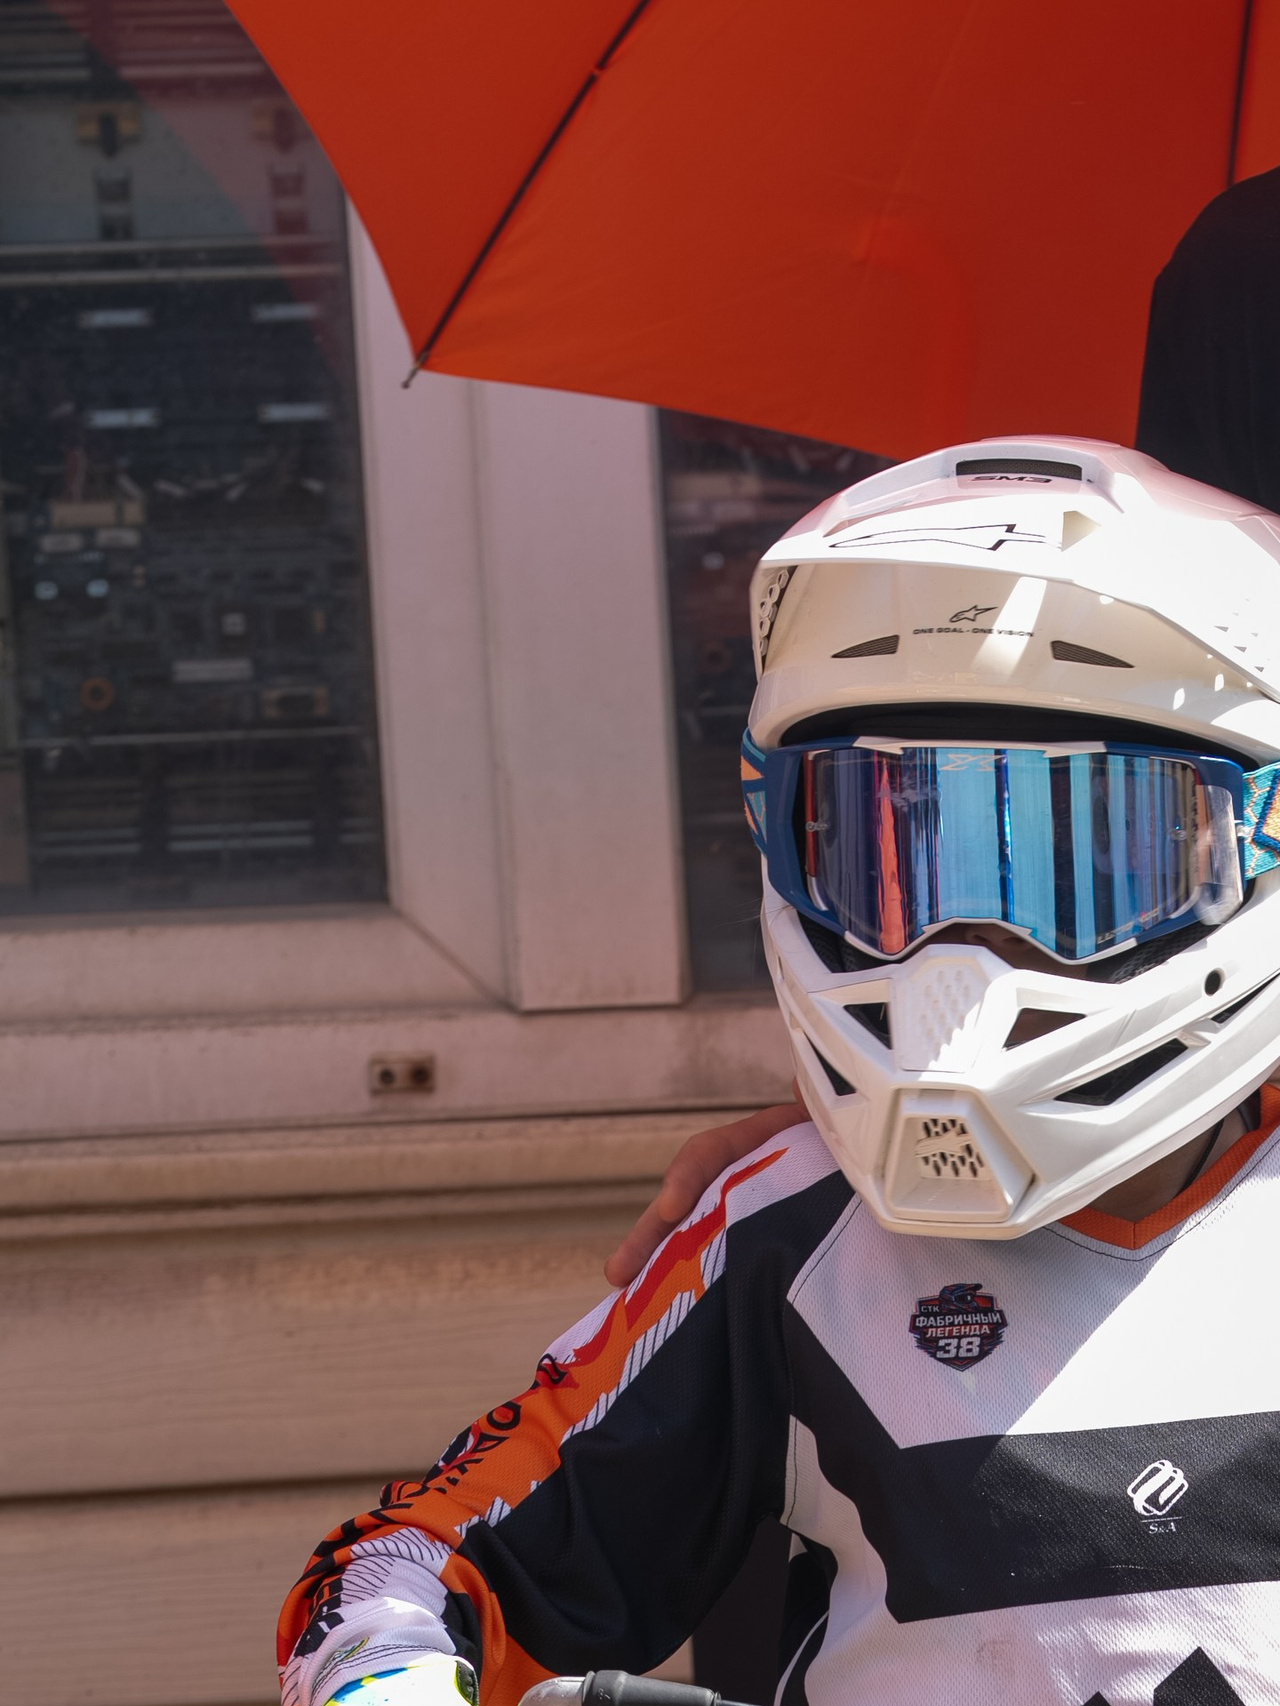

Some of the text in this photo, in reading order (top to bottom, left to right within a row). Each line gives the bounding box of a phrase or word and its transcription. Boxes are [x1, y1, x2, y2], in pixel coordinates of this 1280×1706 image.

[970, 475, 1053, 484] SM3
[912, 627, 935, 635] ONE
[971, 627, 994, 635] ONE
[921, 1305, 940, 1313] СТК
[915, 1310, 1002, 1327] ФАБРИЧНЫЙ
[925, 1325, 990, 1337] ЛЕГЕНДА
[936, 1336, 981, 1358] 38
